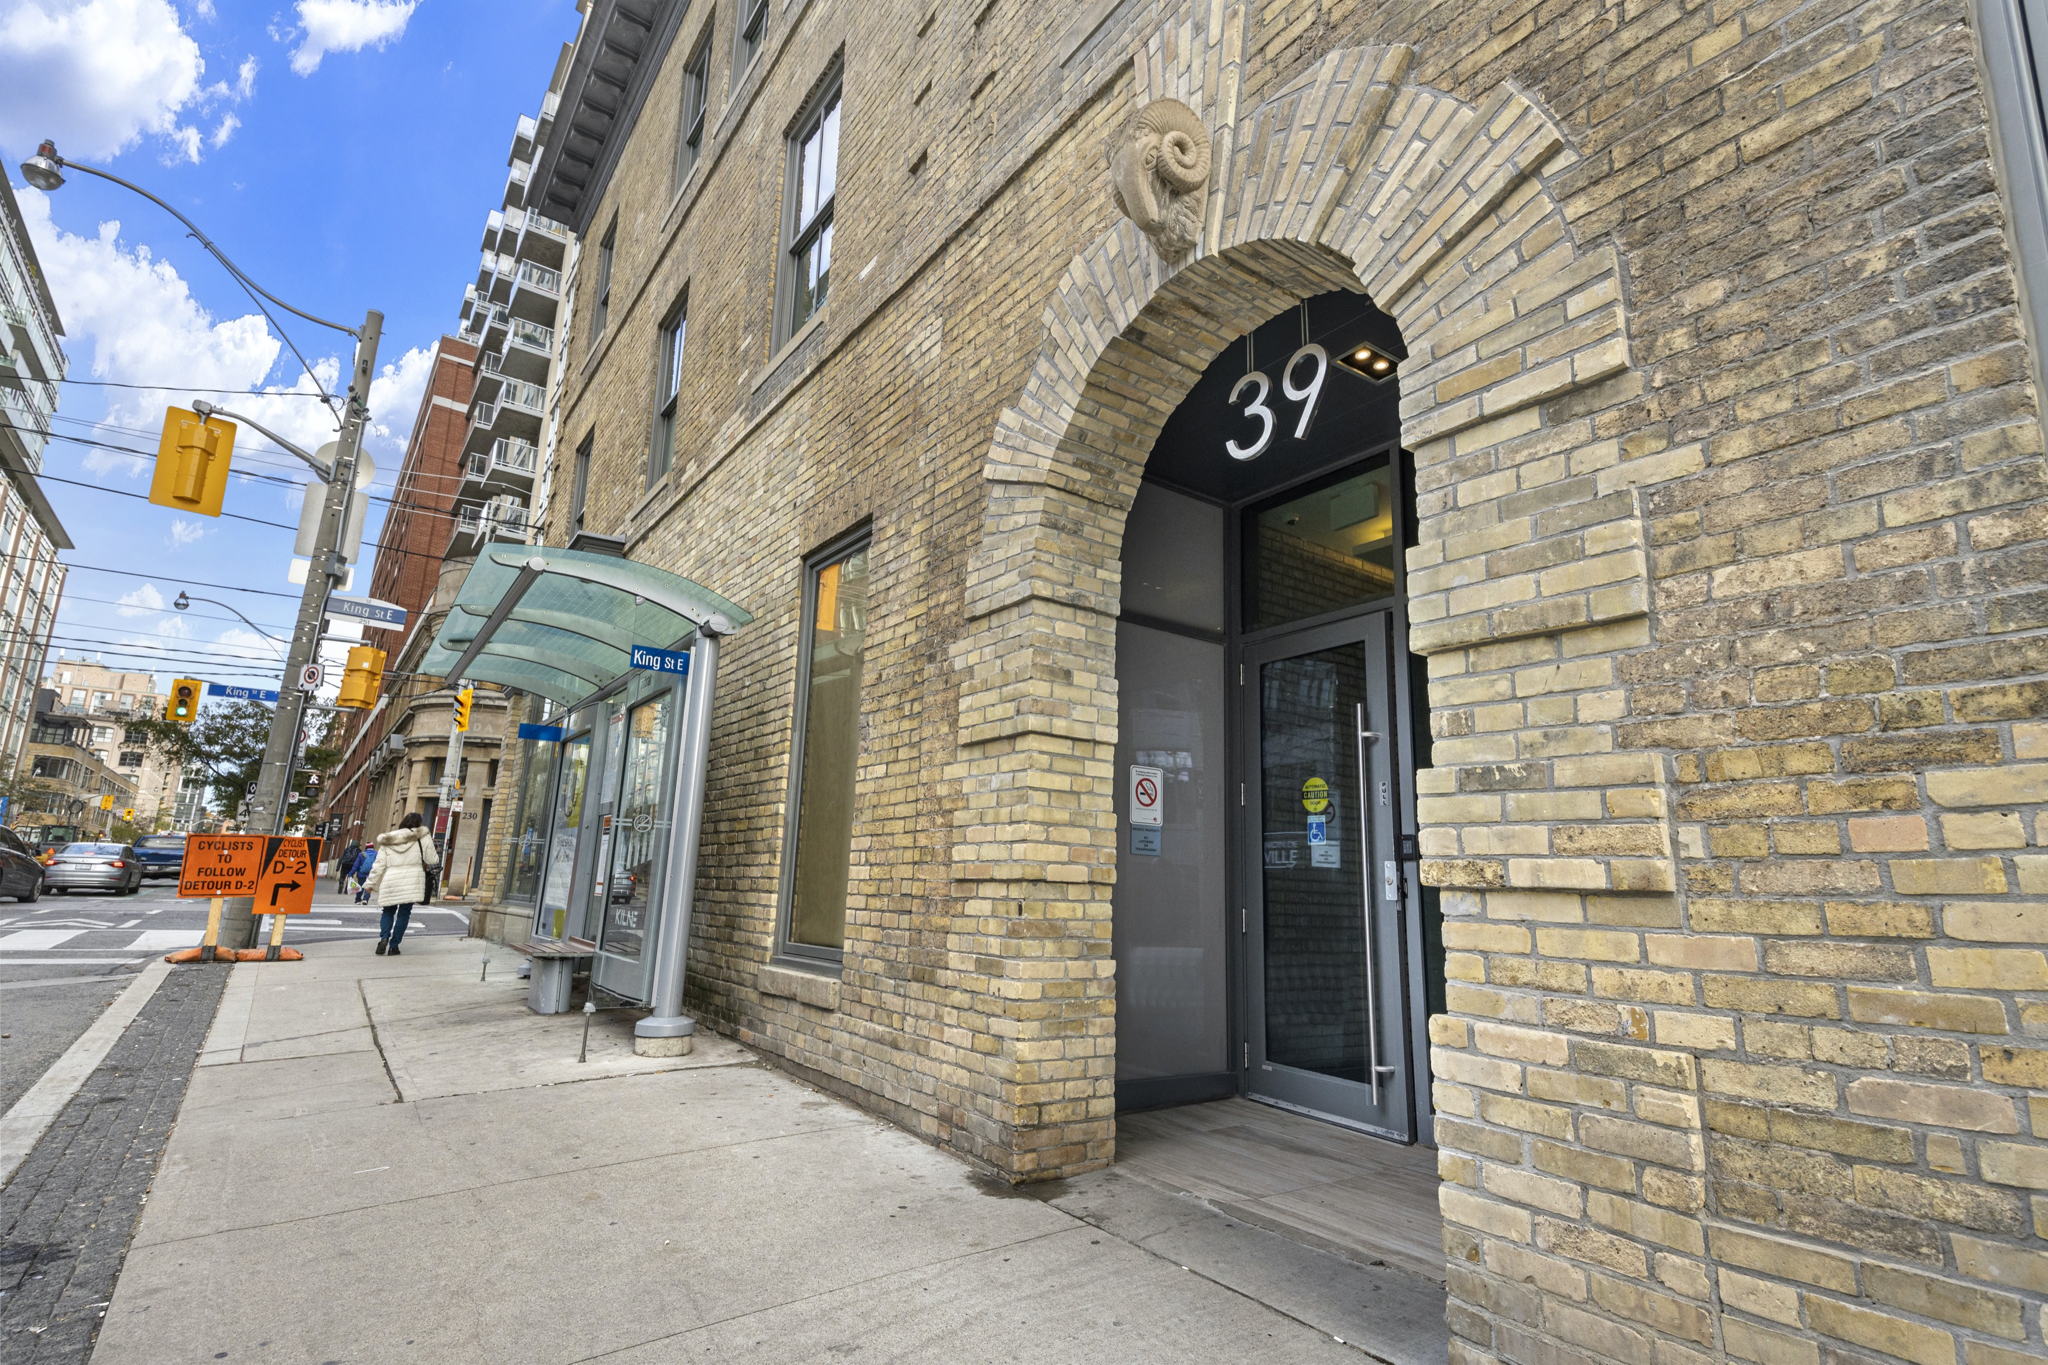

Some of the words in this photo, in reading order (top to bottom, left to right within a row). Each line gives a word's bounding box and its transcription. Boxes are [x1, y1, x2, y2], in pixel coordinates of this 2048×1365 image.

[1225, 343, 1331, 462] 39
[343, 601, 370, 617] King
[374, 608, 384, 619] St
[386, 610, 394, 620] E
[633, 649, 661, 670] King
[664, 657, 674, 670] St
[677, 659, 684, 671] E
[225, 687, 249, 699] King
[260, 690, 267, 699] E
[1303, 791, 1328, 799] CAUTION
[462, 812, 478, 820] 230
[198, 841, 254, 851] CYCLISTS
[283, 840, 306, 848] CYCLIST
[278, 849, 307, 858] DETOUR
[217, 854, 233, 864] TO
[197, 867, 247, 877] FOLLOW
[272, 861, 308, 875] D-2
[184, 880, 232, 890] DETOUR
[234, 880, 255, 890] D-2
